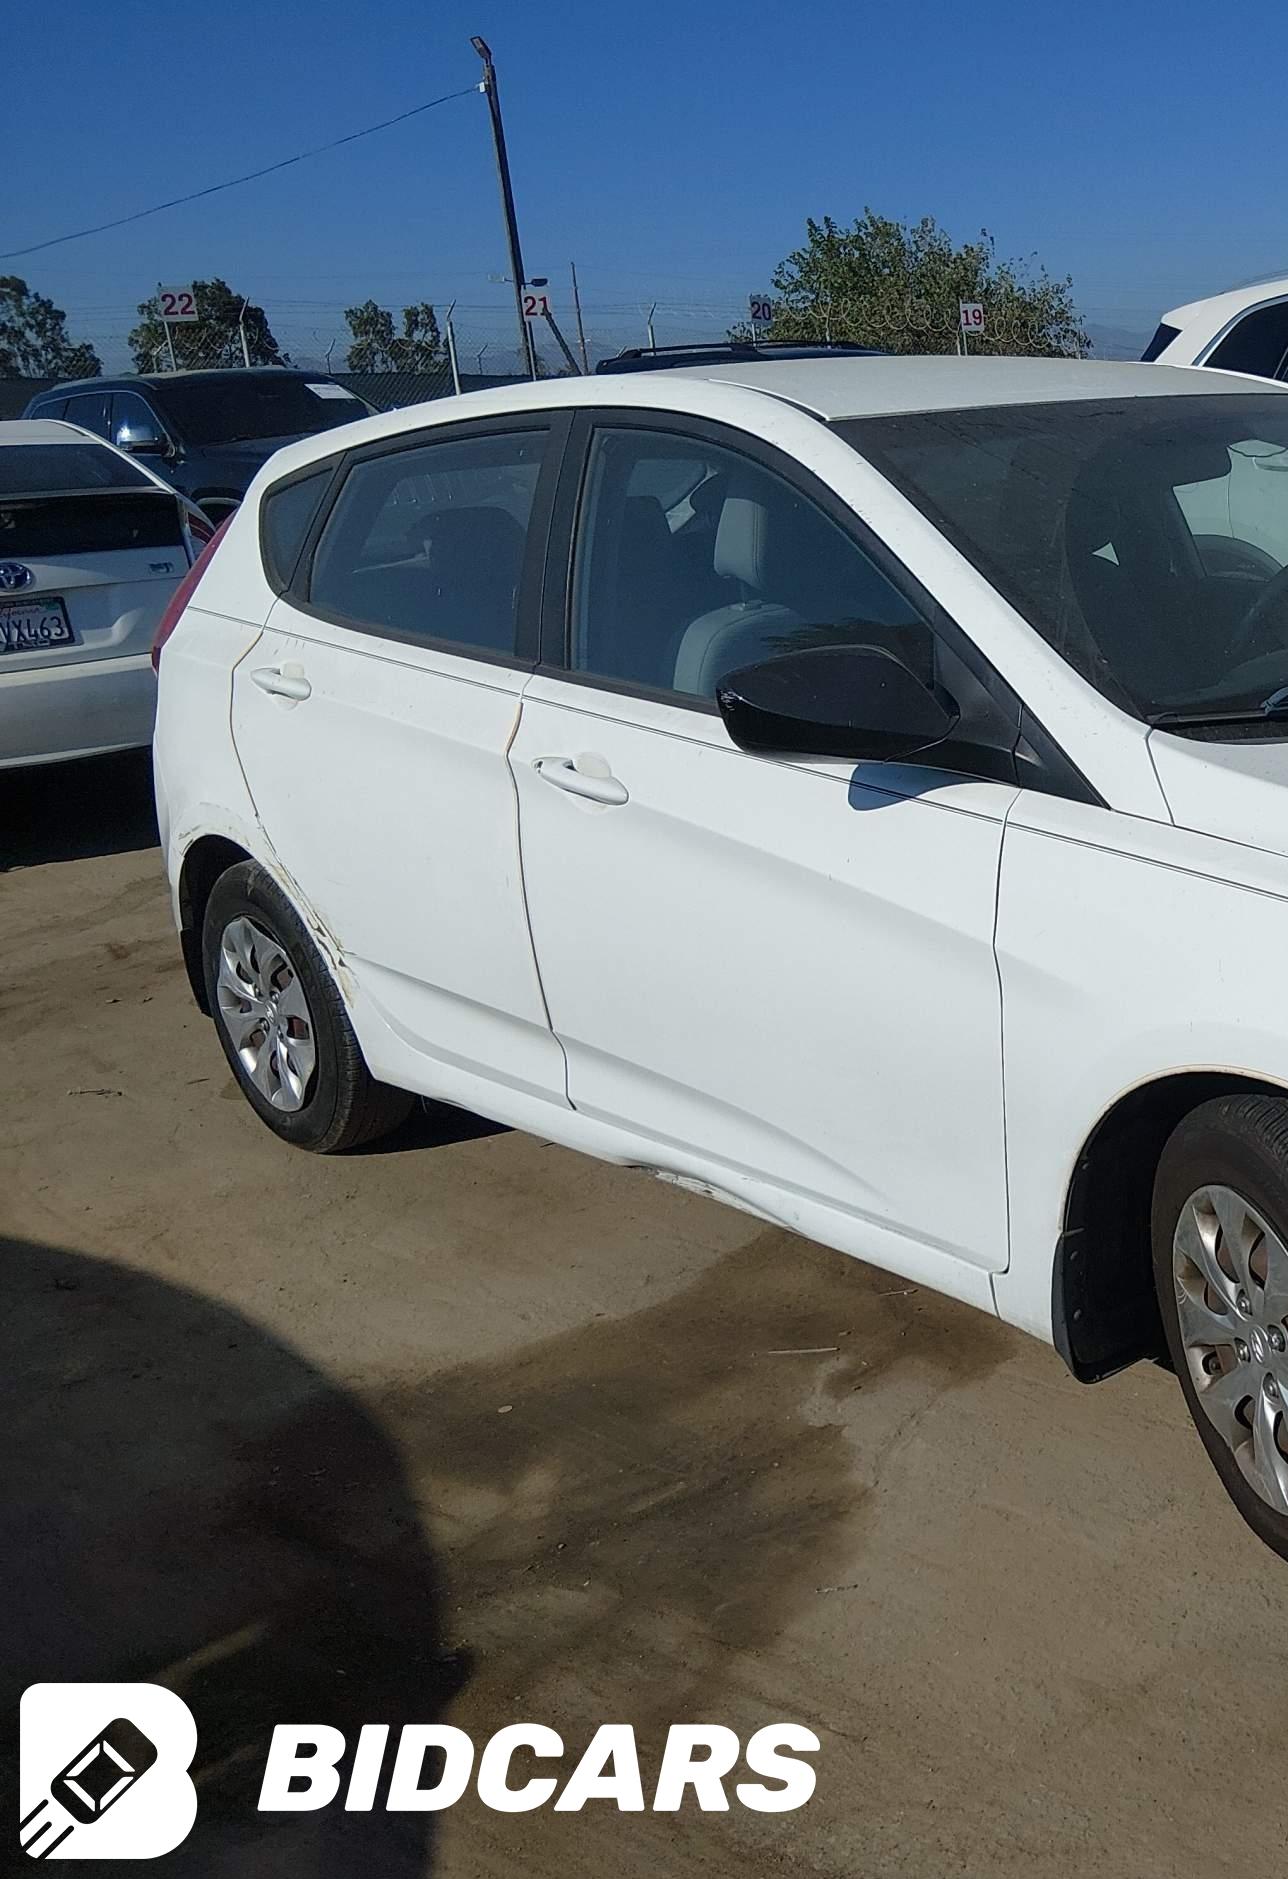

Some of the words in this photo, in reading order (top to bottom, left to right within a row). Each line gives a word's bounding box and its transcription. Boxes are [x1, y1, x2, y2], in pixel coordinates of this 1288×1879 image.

[161, 293, 196, 316] 22
[523, 295, 552, 316] 21
[751, 301, 772, 321] 20
[962, 308, 983, 326] 19
